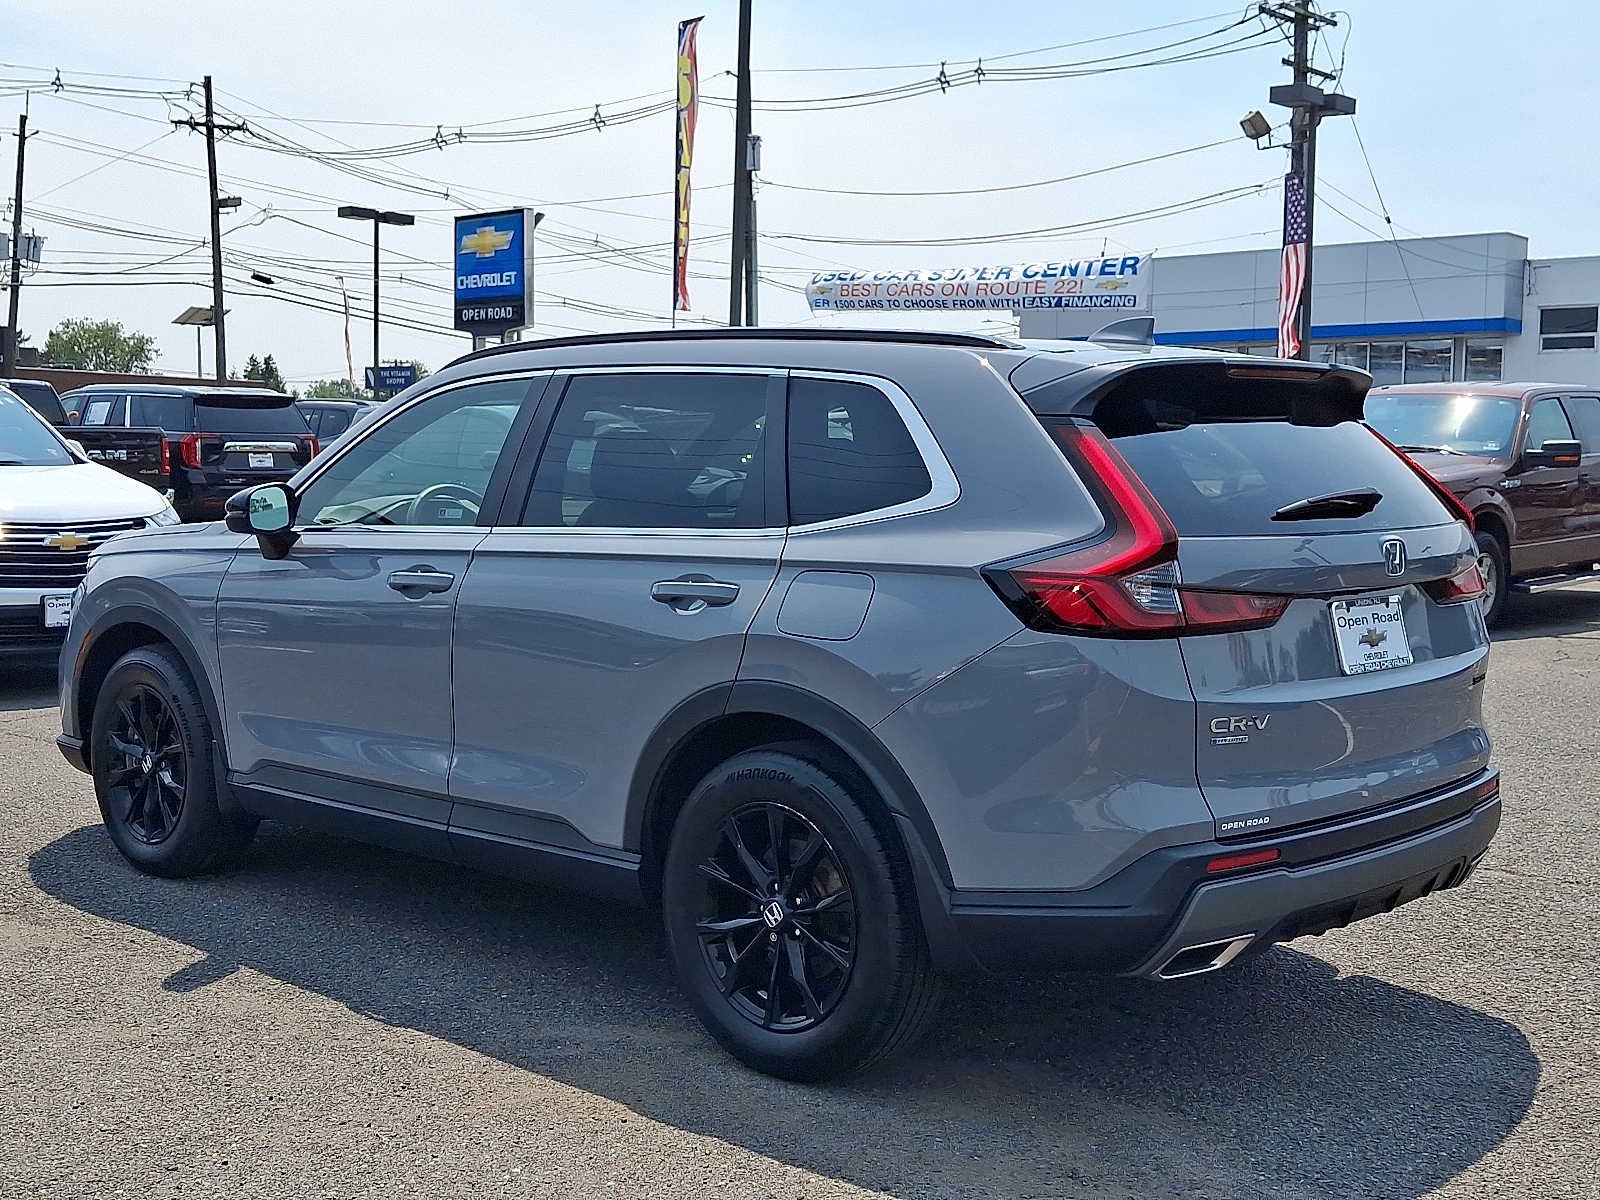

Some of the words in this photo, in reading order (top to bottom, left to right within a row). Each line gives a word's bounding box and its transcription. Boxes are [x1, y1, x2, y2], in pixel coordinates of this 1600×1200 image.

[1022, 256, 1140, 278] CENTER
[457, 271, 517, 289] CHEVROLET
[840, 283, 882, 297] BEST
[886, 282, 936, 297] CARS
[941, 282, 969, 297] ON
[976, 280, 1046, 296] ROUTE
[1053, 279, 1085, 295] 22!
[834, 299, 856, 309] 1500
[857, 299, 884, 309] CARS
[888, 299, 901, 309] TO
[903, 298, 949, 309] CHOOSE
[952, 298, 987, 309] FROM
[989, 297, 1021, 308] WITH
[1024, 296, 1061, 308] EASY
[1061, 295, 1135, 307] FINANCING
[462, 308, 487, 321] OPEN
[488, 306, 513, 319] ROAD
[1337, 614, 1369, 629] Open
[1371, 611, 1400, 625] Road
[1210, 713, 1271, 733] CR-V
[1221, 820, 1245, 831] OPEN
[1246, 816, 1270, 827] ROAD
